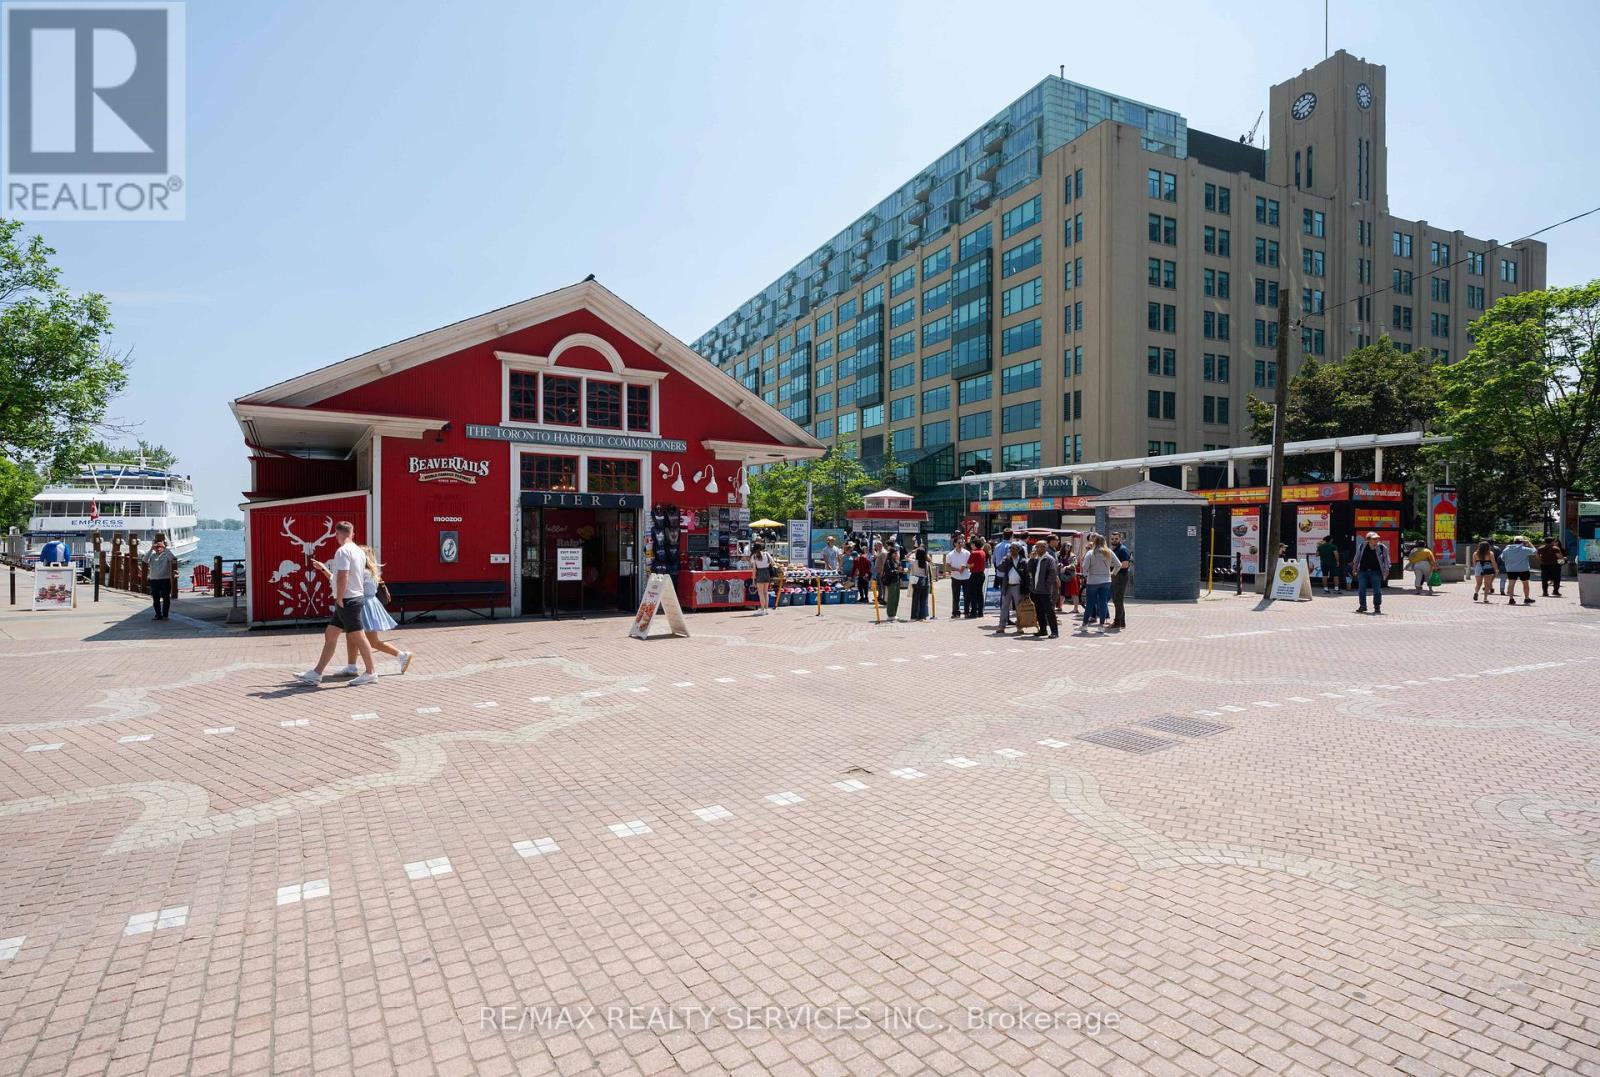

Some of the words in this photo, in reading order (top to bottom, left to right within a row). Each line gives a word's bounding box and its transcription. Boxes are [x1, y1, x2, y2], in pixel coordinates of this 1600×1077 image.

[469, 425, 491, 437] THE
[495, 427, 551, 441] TORONTO
[554, 432, 604, 445] HARBOUR
[607, 436, 687, 451] COMMISSIONERS
[1042, 479, 1068, 487] FARM
[543, 494, 602, 506] PIER
[618, 496, 627, 507] 6
